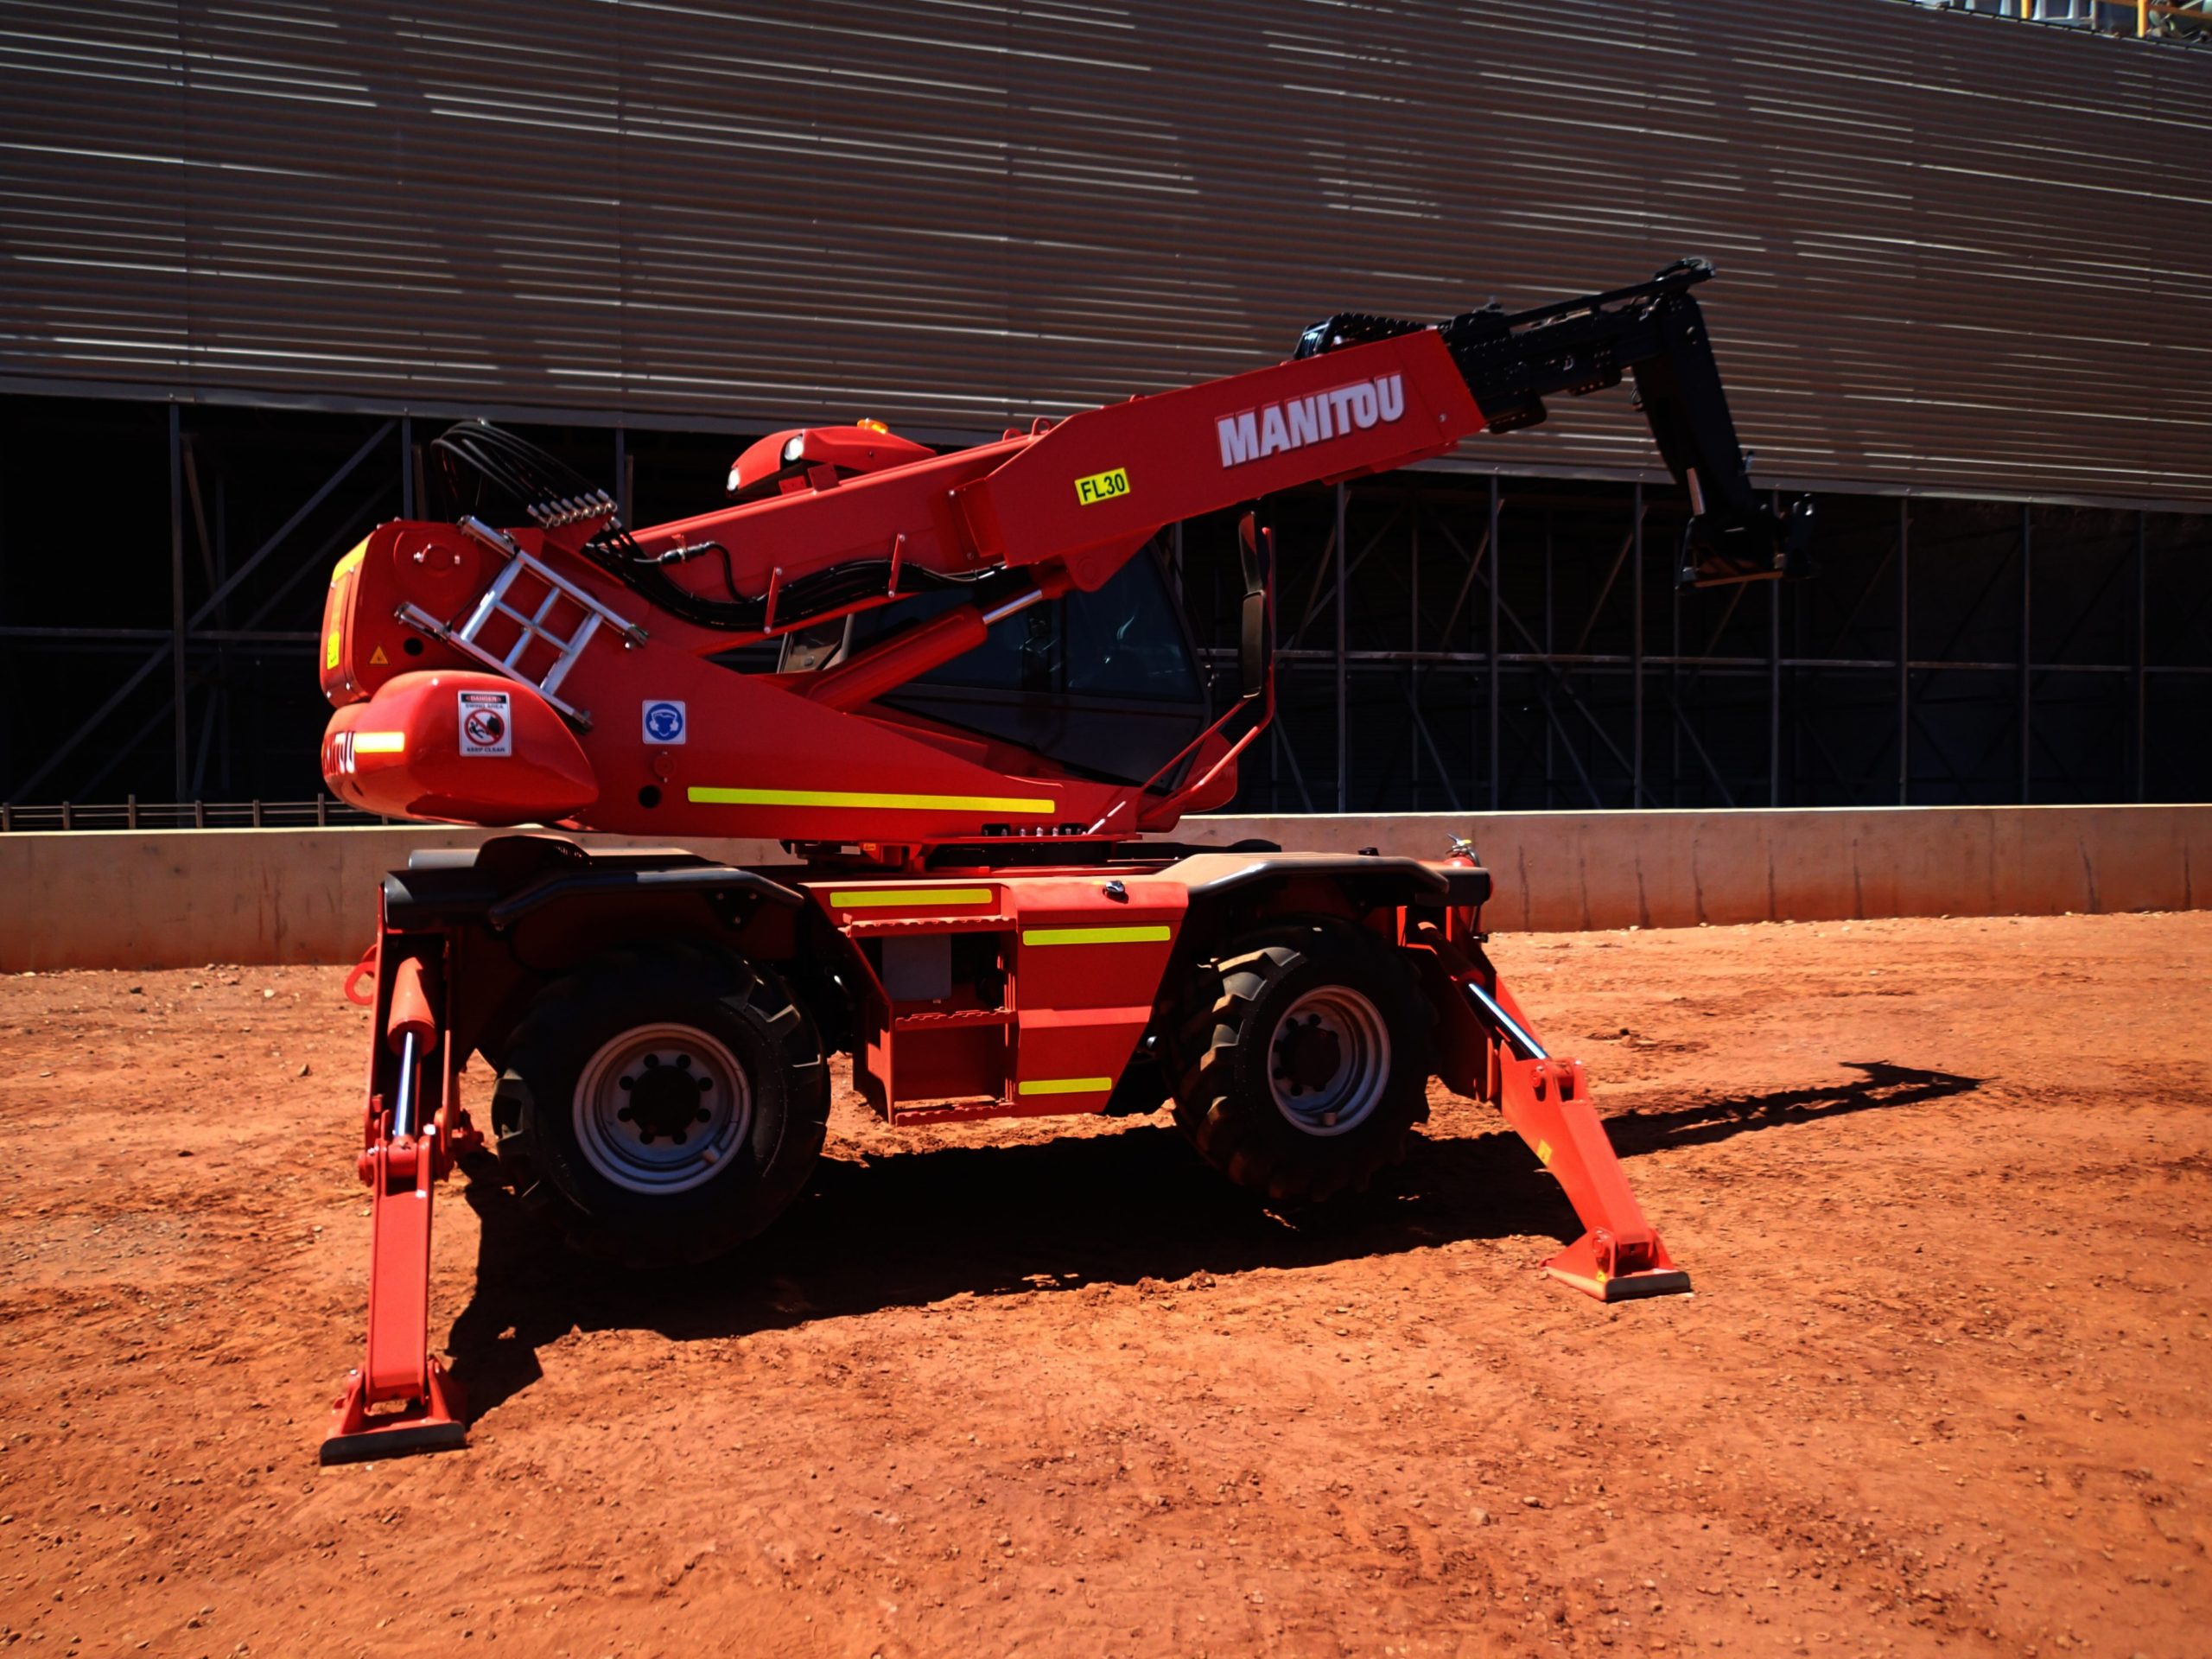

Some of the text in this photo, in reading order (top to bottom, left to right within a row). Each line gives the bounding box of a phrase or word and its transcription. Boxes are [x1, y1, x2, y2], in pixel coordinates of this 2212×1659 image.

[1217, 373, 1404, 467] MANITOU
[1080, 473, 1125, 502] FL30
[470, 695, 498, 703] DANGER
